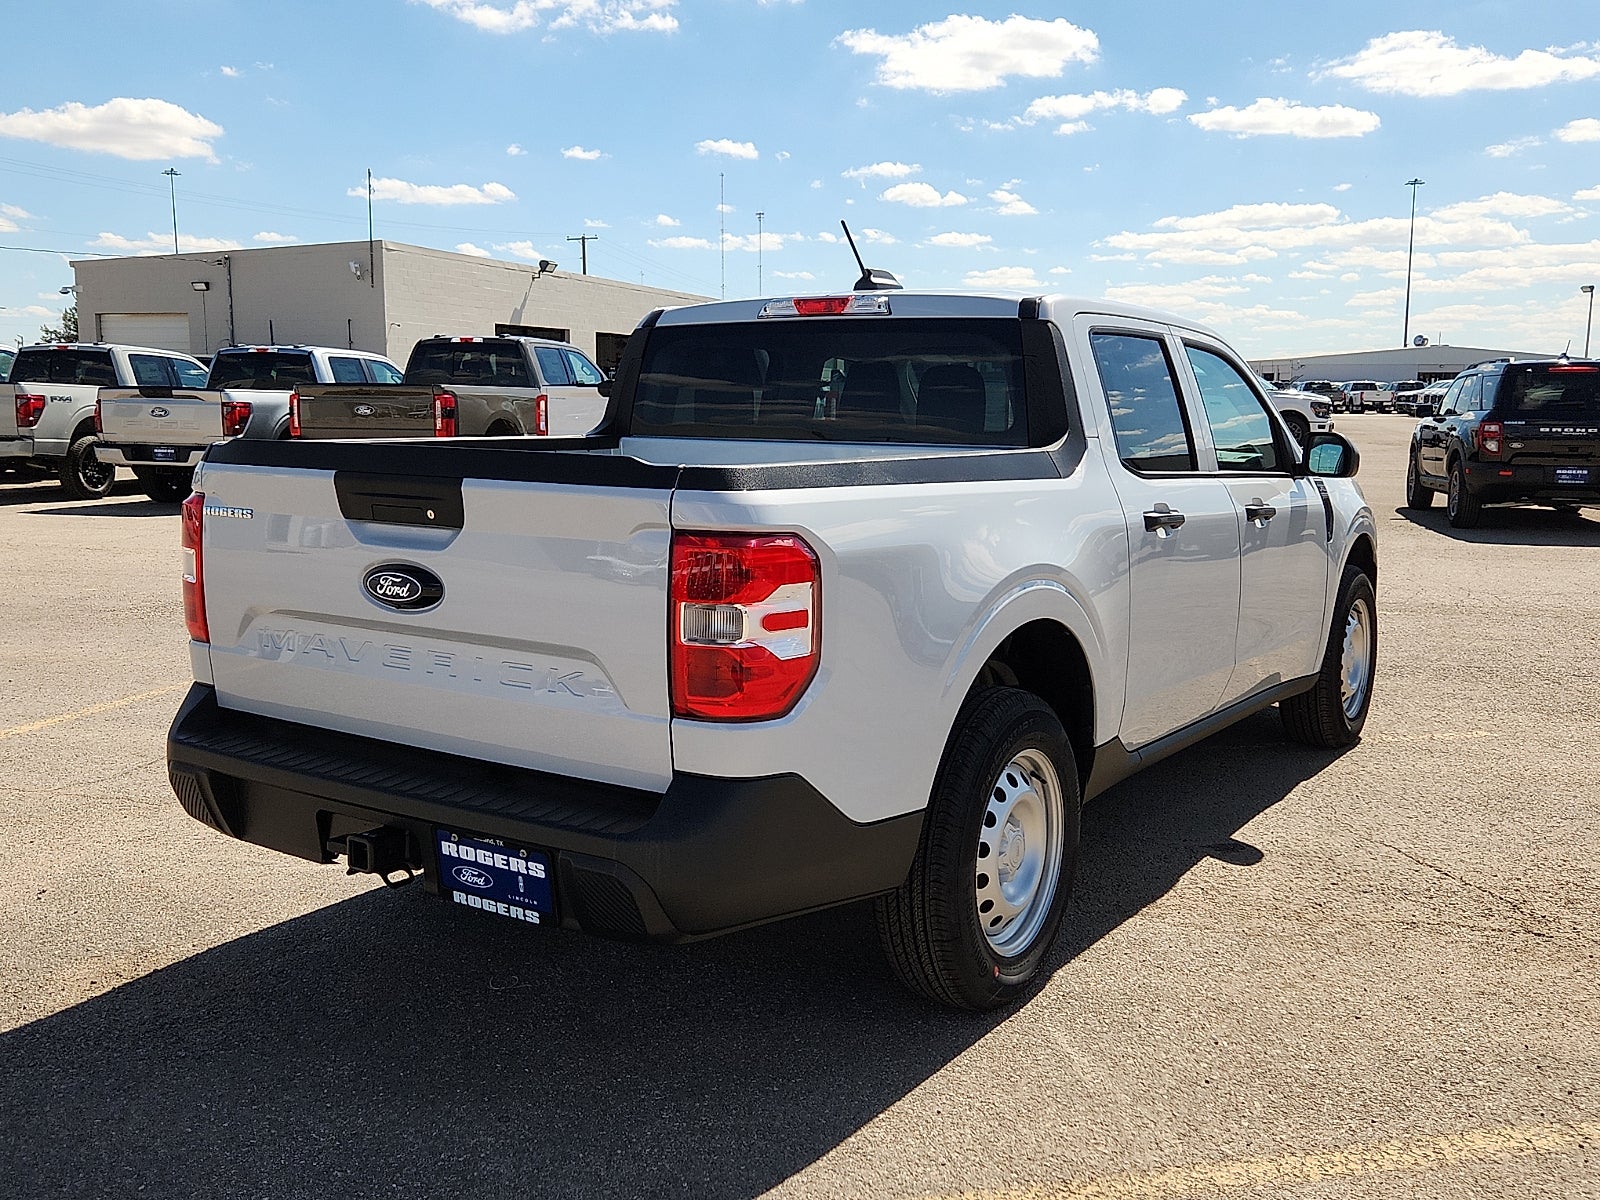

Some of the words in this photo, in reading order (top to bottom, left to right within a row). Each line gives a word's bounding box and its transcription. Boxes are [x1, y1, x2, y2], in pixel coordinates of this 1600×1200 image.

[204, 505, 253, 519] ROGERS
[376, 575, 411, 598] Ford
[260, 628, 586, 698] MAVERICK
[495, 839, 505, 847] TX
[441, 841, 545, 878] ROGERS
[460, 868, 486, 886] Ford
[453, 891, 540, 924] ROGERS
[508, 894, 538, 905] LINCOLN
